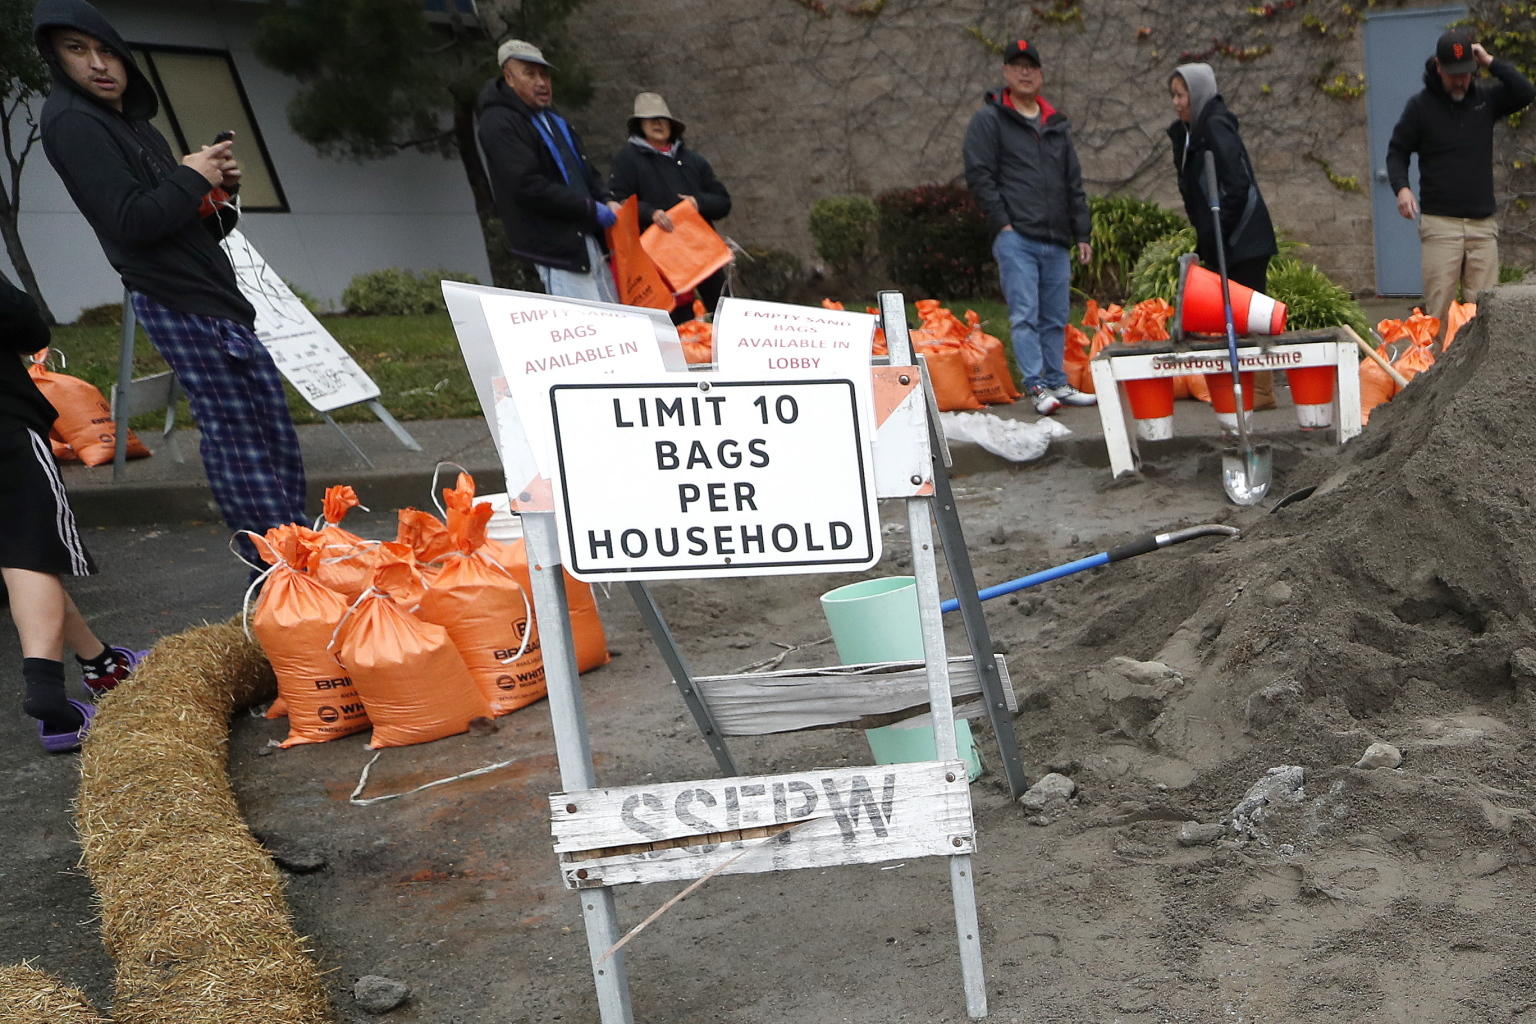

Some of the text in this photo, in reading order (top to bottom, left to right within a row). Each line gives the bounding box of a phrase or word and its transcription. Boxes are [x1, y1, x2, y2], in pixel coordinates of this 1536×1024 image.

[510, 308, 570, 325] EMPTY
[744, 310, 851, 327] EMPTY SAND
[550, 324, 597, 343] BAGS
[773, 324, 818, 333] BAGS
[738, 337, 850, 349] AVAILABLE IN
[525, 341, 639, 375] AVAILABLE IN
[768, 357, 821, 370] LOBBY
[1152, 356, 1225, 371] Sandbag
[613, 394, 800, 428] LIMIT 10
[655, 438, 771, 470] BAGS
[679, 481, 758, 513] PER
[587, 520, 854, 560] HOUSEHOLD
